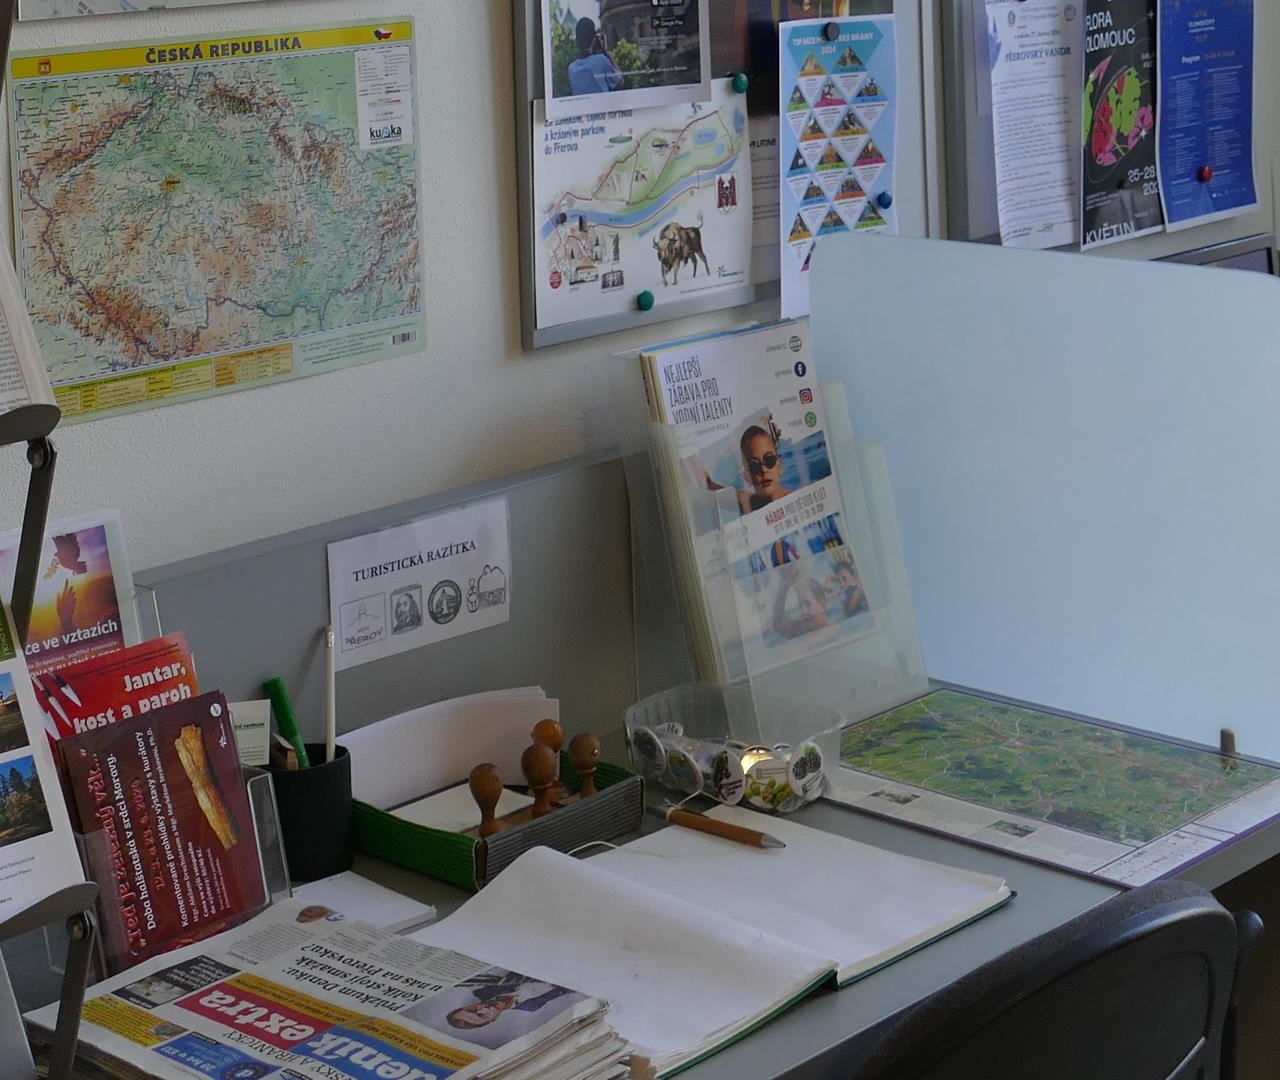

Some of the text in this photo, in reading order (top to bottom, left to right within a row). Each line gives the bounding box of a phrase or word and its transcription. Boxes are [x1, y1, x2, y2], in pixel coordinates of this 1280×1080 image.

[1086, 10, 1112, 32] FLORA
[145, 36, 302, 64] ČESKÁ REPUBLIKA
[1044, 47, 1071, 58] VANDR
[1086, 28, 1135, 53] OLOMOUC
[664, 356, 702, 384] NEJLEPŠÍ
[668, 377, 719, 407] ZÁBAVA PRO
[673, 397, 733, 424] VODNÍ TALENTY
[352, 540, 476, 582] TURISTICKÁ RAZÍTKA
[42, 636, 60, 651] ve
[62, 619, 118, 645] vztazích
[124, 662, 186, 692] Jantar,
[73, 683, 192, 734] kost a paroh
[134, 731, 154, 770] kurátory
[146, 779, 163, 814] výstavy
[107, 753, 156, 929] Doba halštatská v srdci Moravy.
[154, 815, 175, 860] prohlídky
[116, 882, 135, 900] je
[167, 861, 189, 927] Komentované
[295, 955, 425, 1002] Kolik stojí smažák
[300, 943, 443, 991] u nás na Přerovsku?
[280, 966, 408, 1012] Průzkum Deníku:
[198, 990, 315, 1041] extra
[221, 1030, 298, 1065] HRANICKÝ
